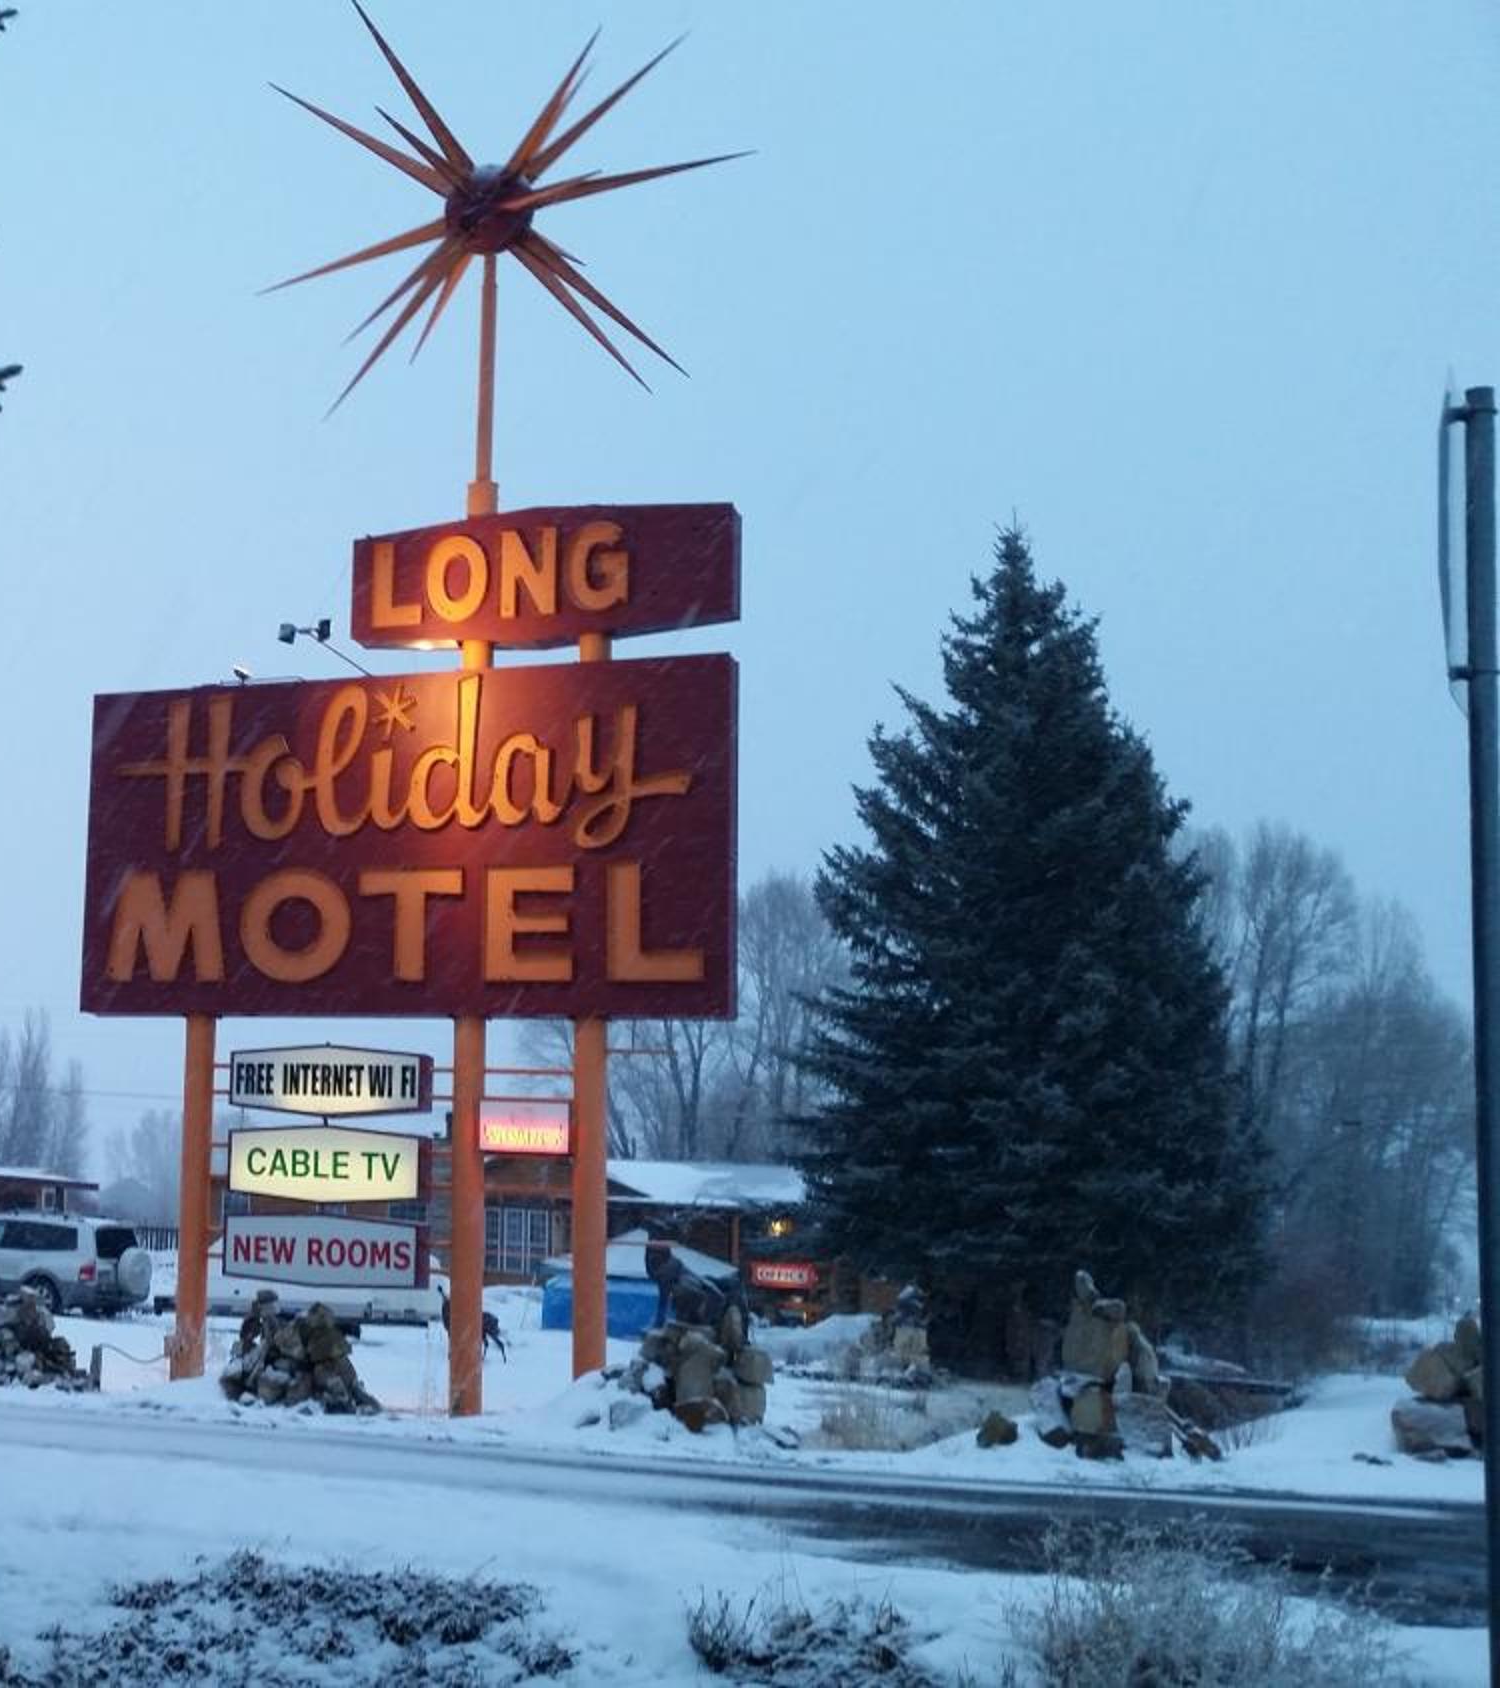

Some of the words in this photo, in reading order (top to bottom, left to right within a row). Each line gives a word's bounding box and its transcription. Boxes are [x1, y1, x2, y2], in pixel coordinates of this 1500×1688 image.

[370, 519, 630, 629] LONG
[114, 673, 694, 852] Holiday
[106, 862, 704, 983] MOTEL
[235, 1062, 275, 1096] FREE
[282, 1062, 364, 1098] INTERNET
[367, 1064, 393, 1098] WI
[401, 1064, 416, 1099] FI
[247, 1147, 350, 1179] CABLE
[360, 1151, 400, 1182] TV
[232, 1234, 296, 1265] NEW
[306, 1237, 411, 1271] ROOMS
[756, 1266, 808, 1284] OFFICE
